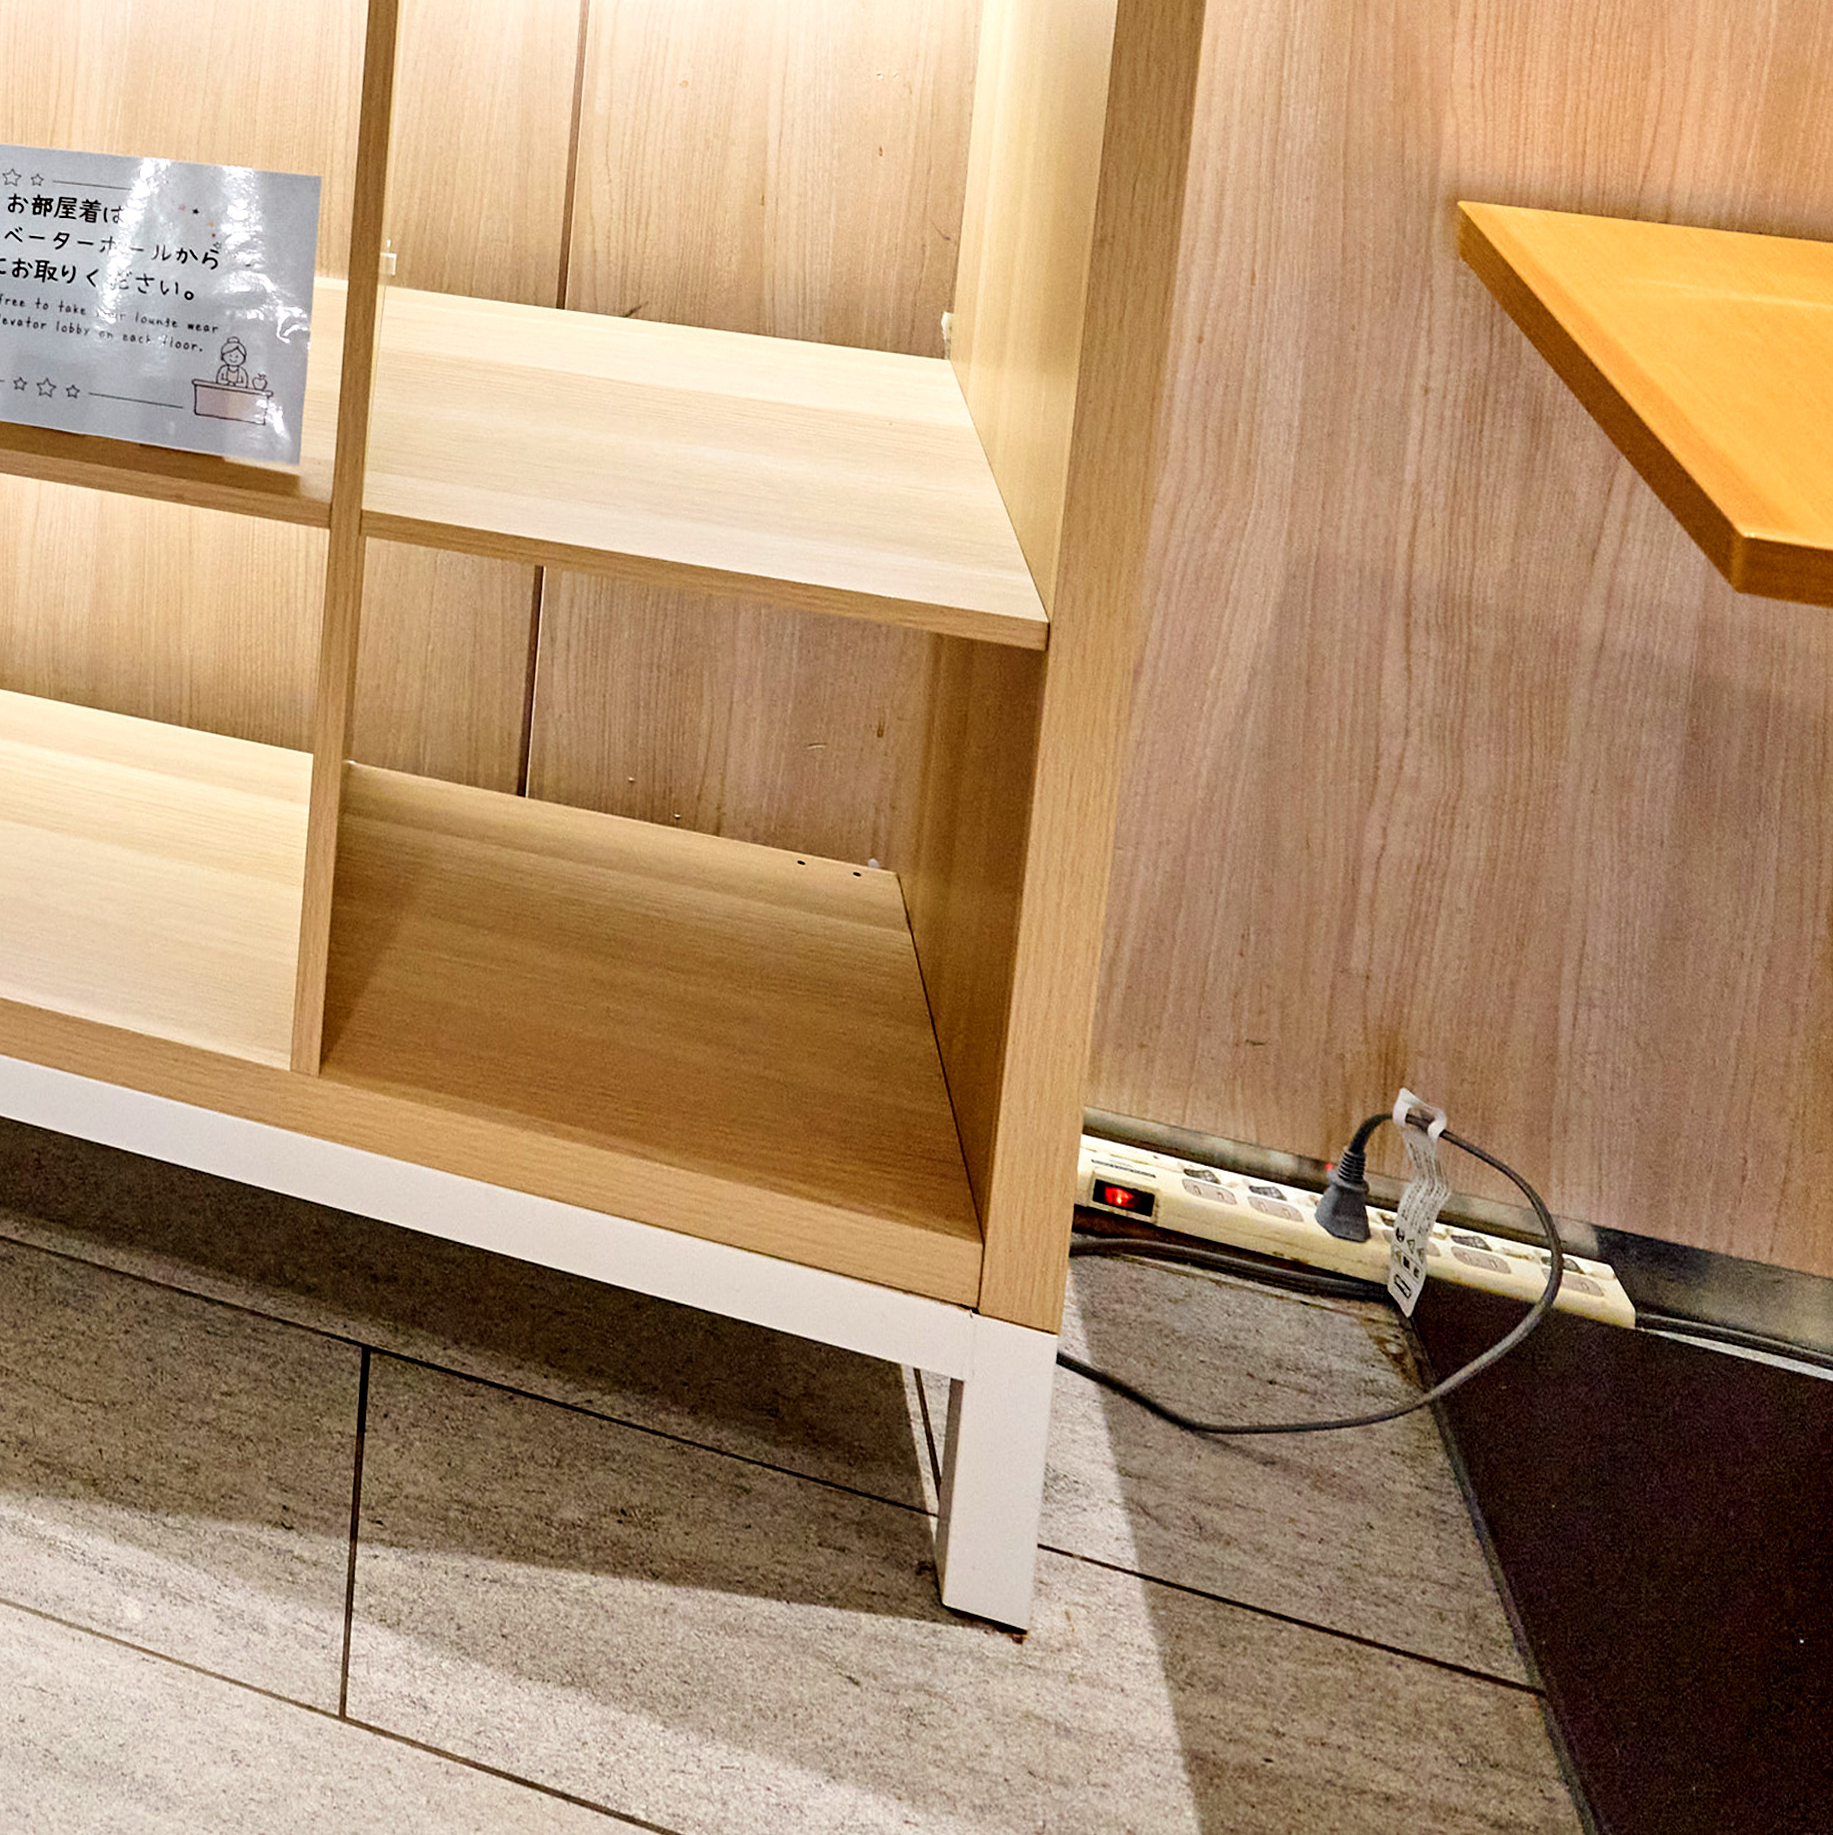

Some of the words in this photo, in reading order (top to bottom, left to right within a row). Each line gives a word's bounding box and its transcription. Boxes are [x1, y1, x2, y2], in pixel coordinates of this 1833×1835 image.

[7, 193, 125, 224] お部屋着は
[35, 298, 50, 310] to
[58, 300, 87, 316] take
[187, 323, 219, 334] wear
[55, 322, 90, 336] lobby
